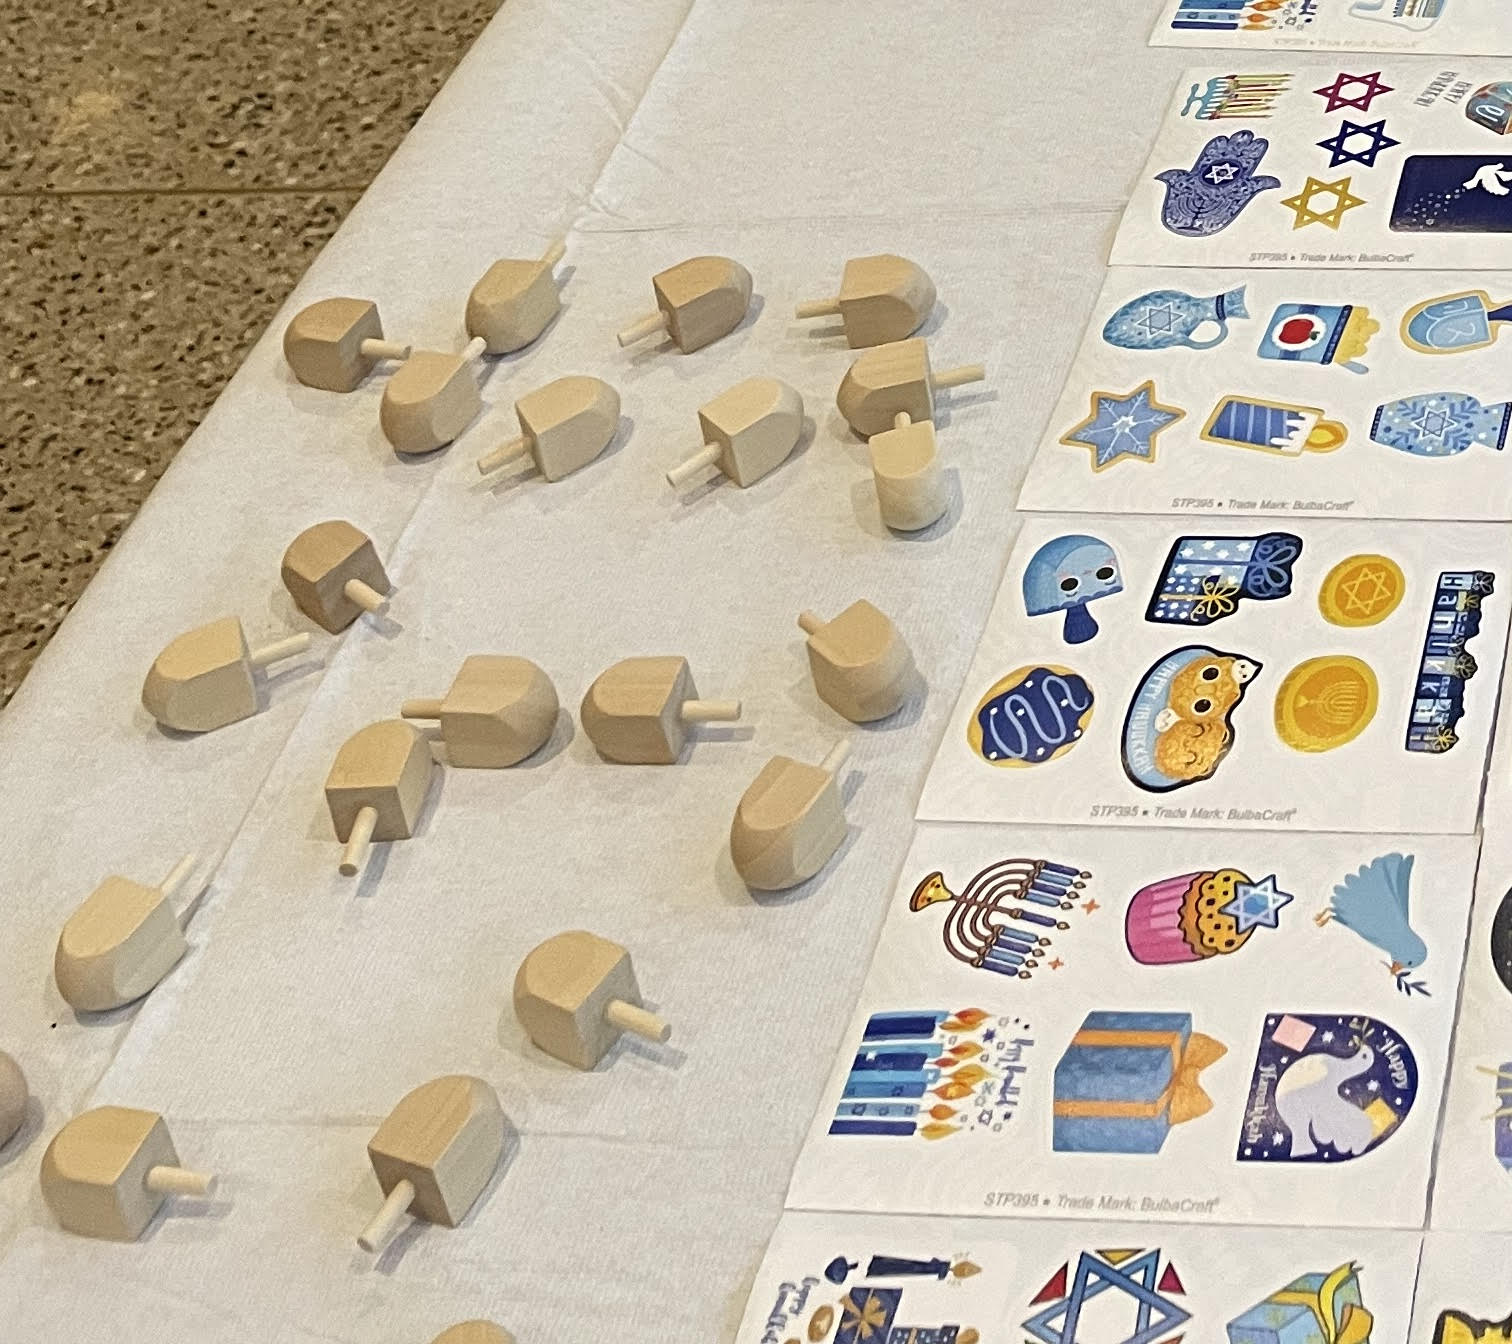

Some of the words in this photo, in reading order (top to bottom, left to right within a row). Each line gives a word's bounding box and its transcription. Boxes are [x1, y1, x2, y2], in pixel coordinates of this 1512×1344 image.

[1227, 499, 1257, 510] Trade
[1090, 806, 1139, 818] STP395
[1154, 807, 1188, 819] Trade
[1375, 1031, 1410, 1090] Happy
[983, 1192, 1039, 1208] STP395
[1056, 1195, 1094, 1210] Trade
